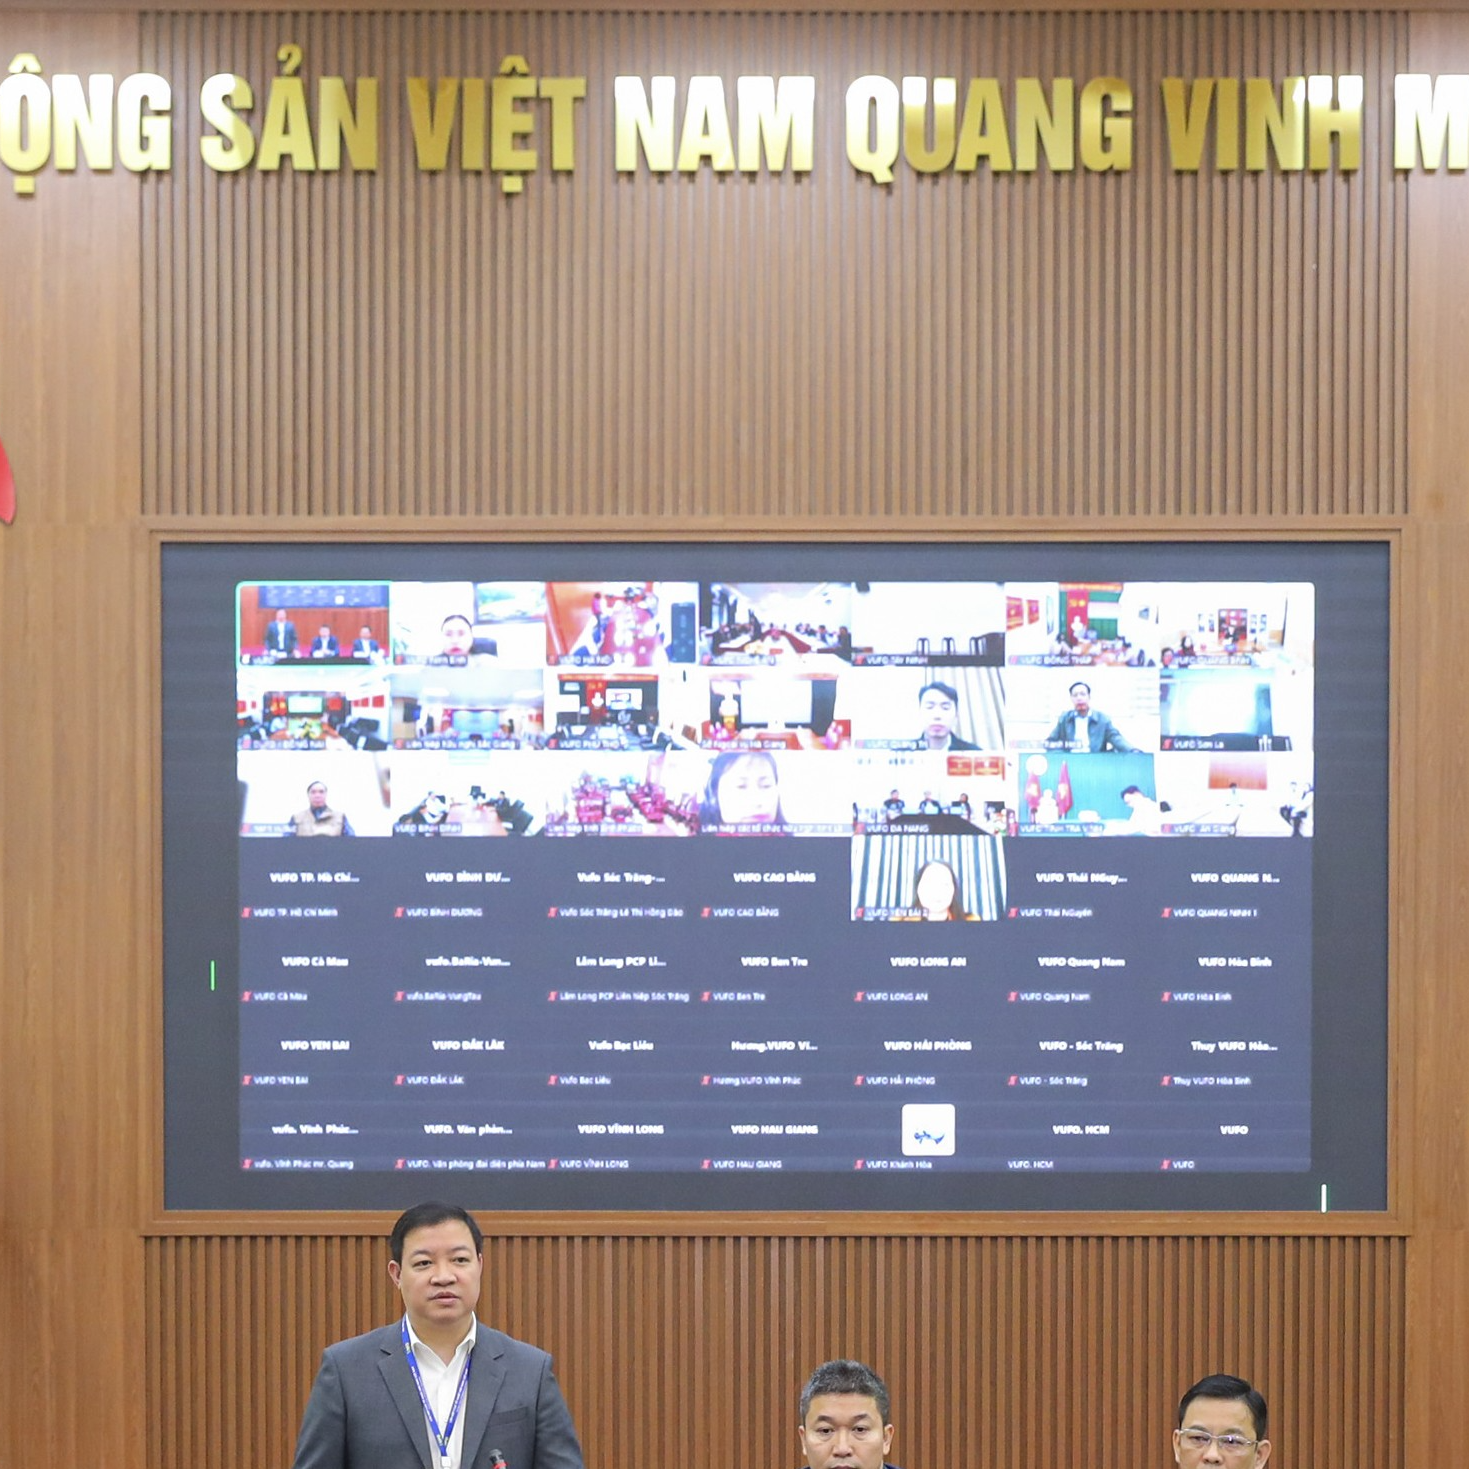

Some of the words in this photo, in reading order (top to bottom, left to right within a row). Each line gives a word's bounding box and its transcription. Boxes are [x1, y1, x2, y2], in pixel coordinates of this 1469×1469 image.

[199, 43, 379, 172] SẢN
[406, 54, 587, 194] VIỆT
[614, 74, 816, 173] NAM
[843, 74, 1133, 184] QUANG
[1162, 75, 1364, 173] VINH
[270, 873, 298, 882] VUFO
[426, 873, 453, 882] VUFO
[733, 873, 762, 882] VUFO
[1036, 873, 1064, 882] VUFO
[1191, 873, 1219, 882] VUFO
[282, 957, 310, 966] VUFO
[741, 957, 769, 966] VUFO
[890, 957, 919, 966] VUFO
[920, 957, 949, 966] LONG
[951, 957, 966, 966] AN
[1038, 957, 1066, 966] VUFO
[1198, 957, 1226, 966] VUFO
[281, 1041, 309, 1050] VUFO
[432, 1041, 461, 1050] VUFO
[884, 1041, 912, 1050] VUFO
[1039, 1041, 1067, 1050] VUFO
[1218, 1041, 1246, 1050] VUFO
[578, 1125, 606, 1134] VUFO
[731, 1125, 759, 1134] VUFO
[1220, 1125, 1248, 1134] VUFO
